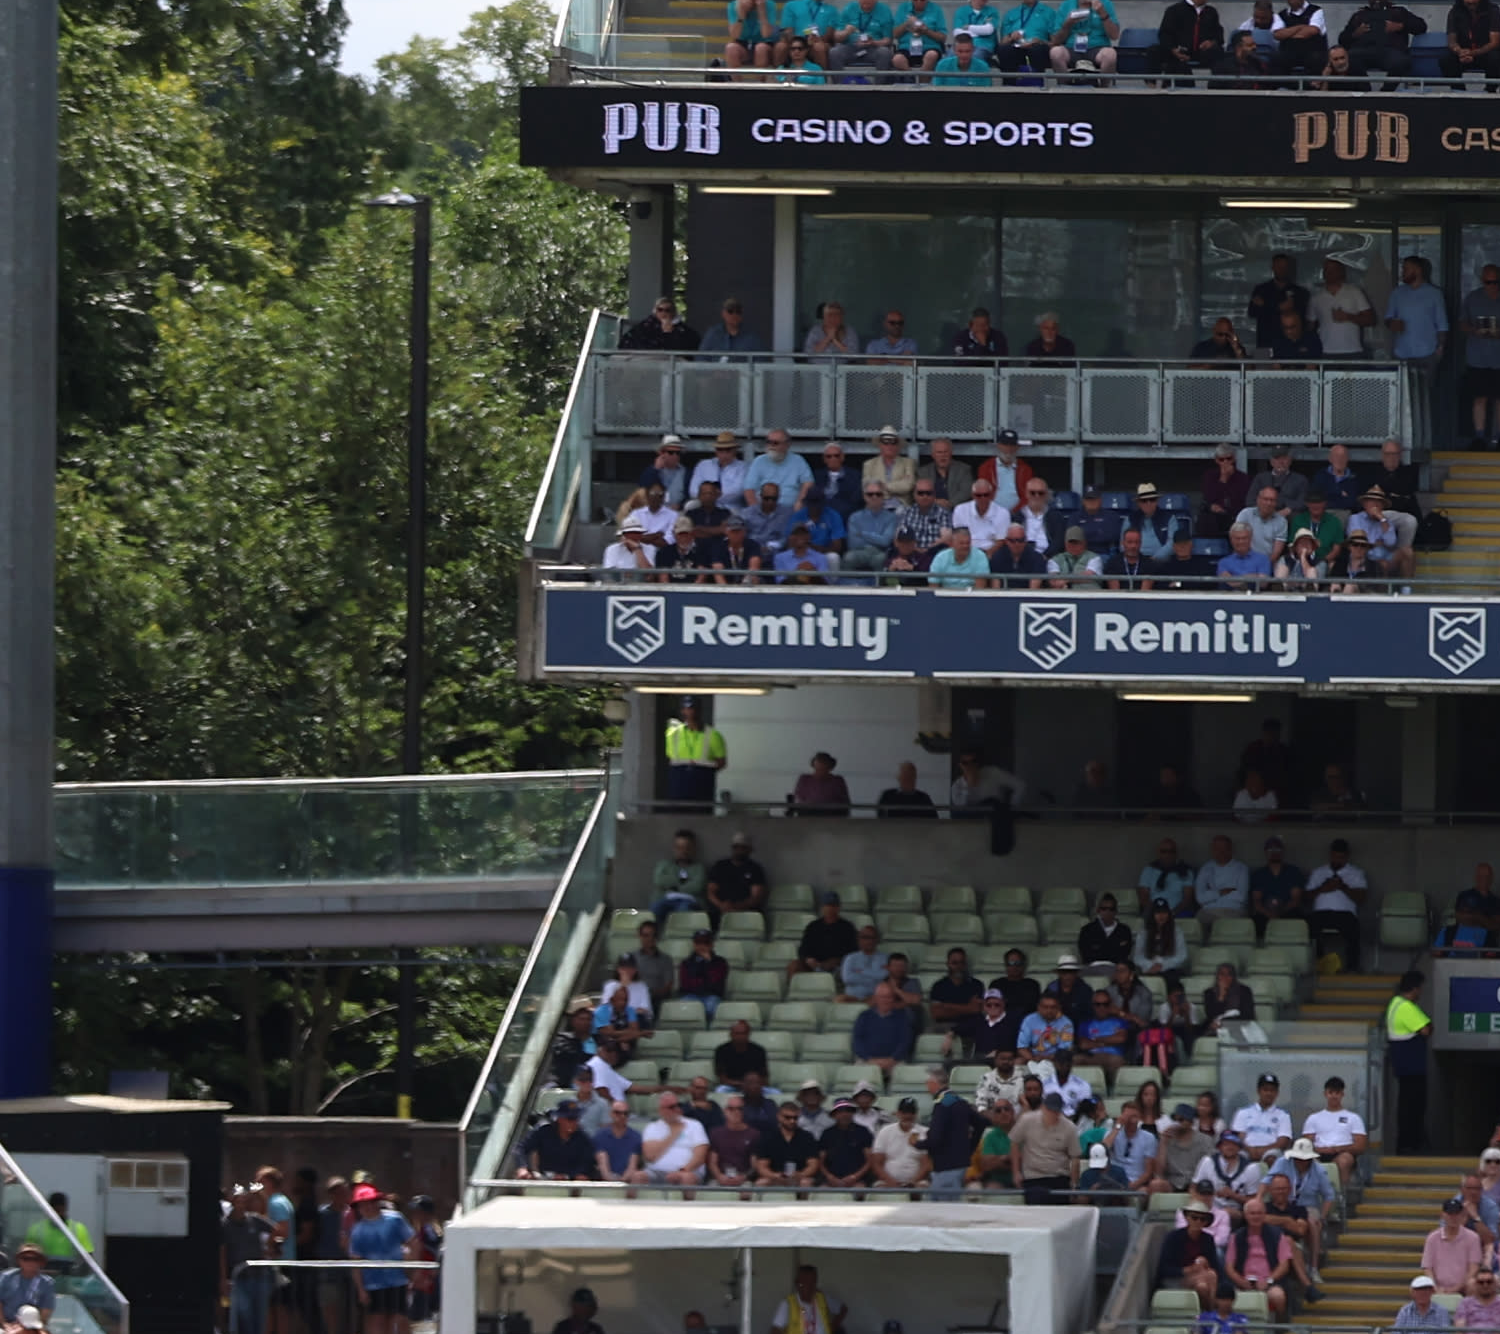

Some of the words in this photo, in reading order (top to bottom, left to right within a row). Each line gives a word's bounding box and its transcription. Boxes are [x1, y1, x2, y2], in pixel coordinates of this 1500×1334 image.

[602, 102, 720, 155] PUB
[752, 118, 891, 145] CASINO
[903, 120, 931, 146] &
[943, 121, 1094, 147] SPORTS
[1293, 111, 1409, 163] PUB
[683, 603, 887, 660] Remitly
[1095, 610, 1298, 667] Remitly
